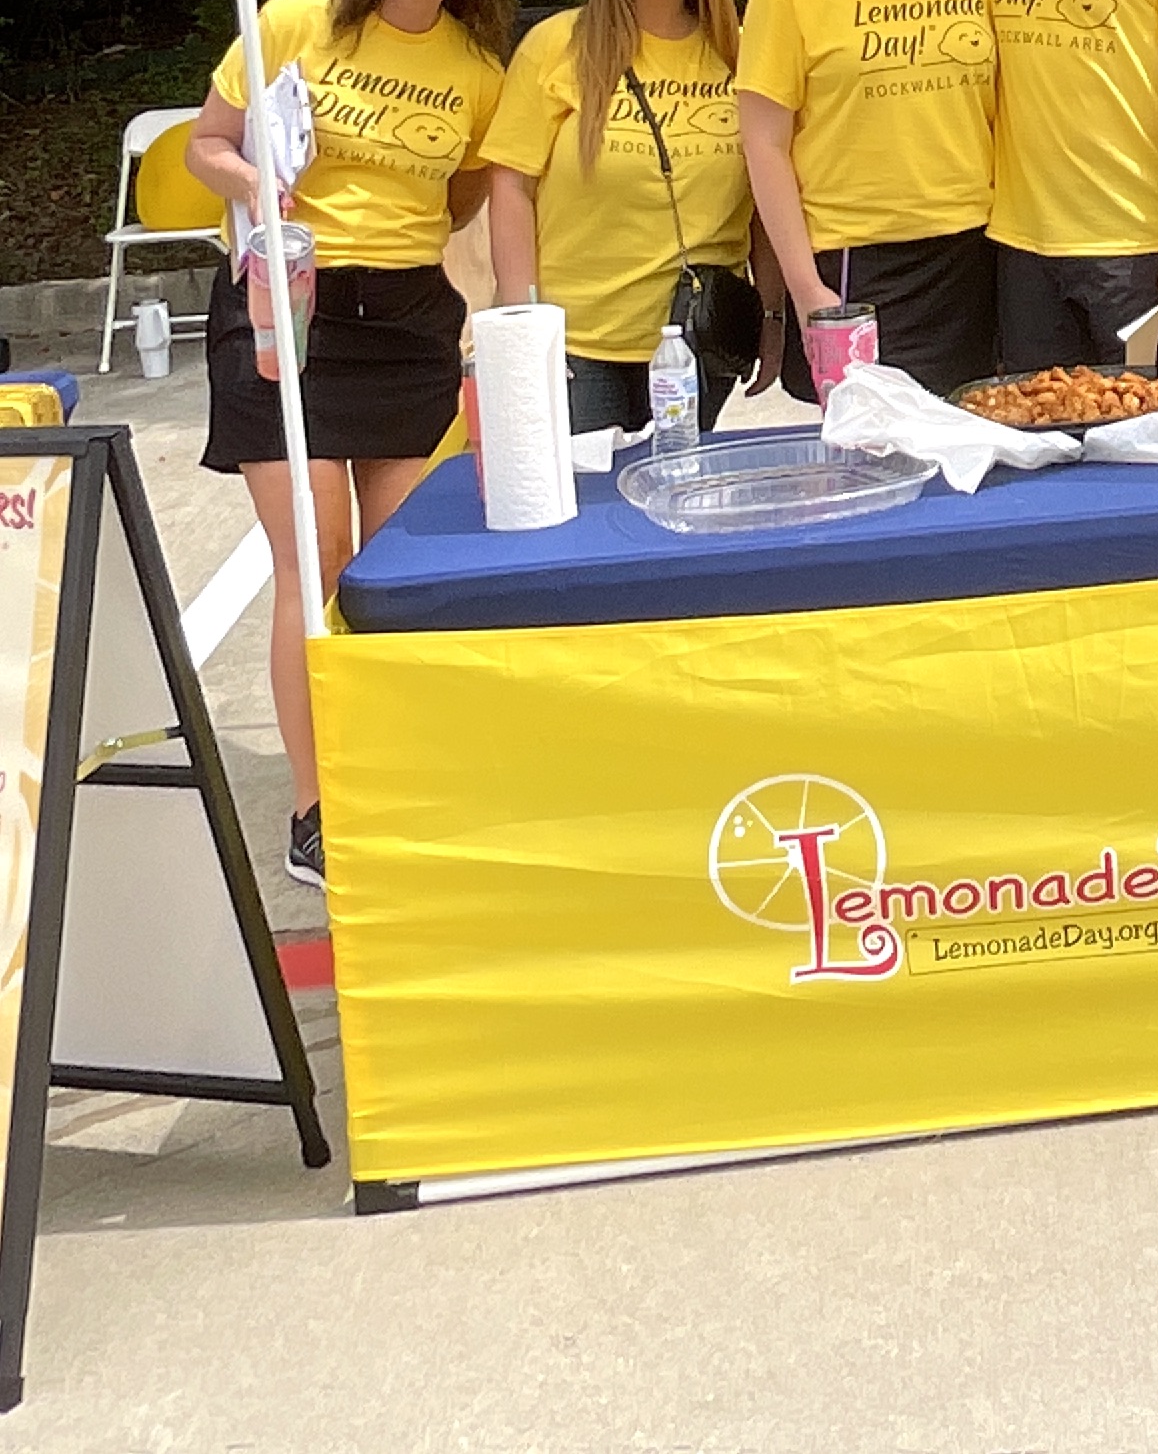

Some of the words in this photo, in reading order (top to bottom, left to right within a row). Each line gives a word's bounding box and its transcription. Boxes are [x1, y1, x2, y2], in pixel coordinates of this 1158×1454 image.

[861, 25, 926, 65] Day!
[1070, 36, 1116, 54] AREA
[318, 57, 464, 114] Lemonade
[865, 76, 954, 99] ROCKWALL
[313, 92, 389, 137] Day!
[609, 140, 704, 158] ROCKALL
